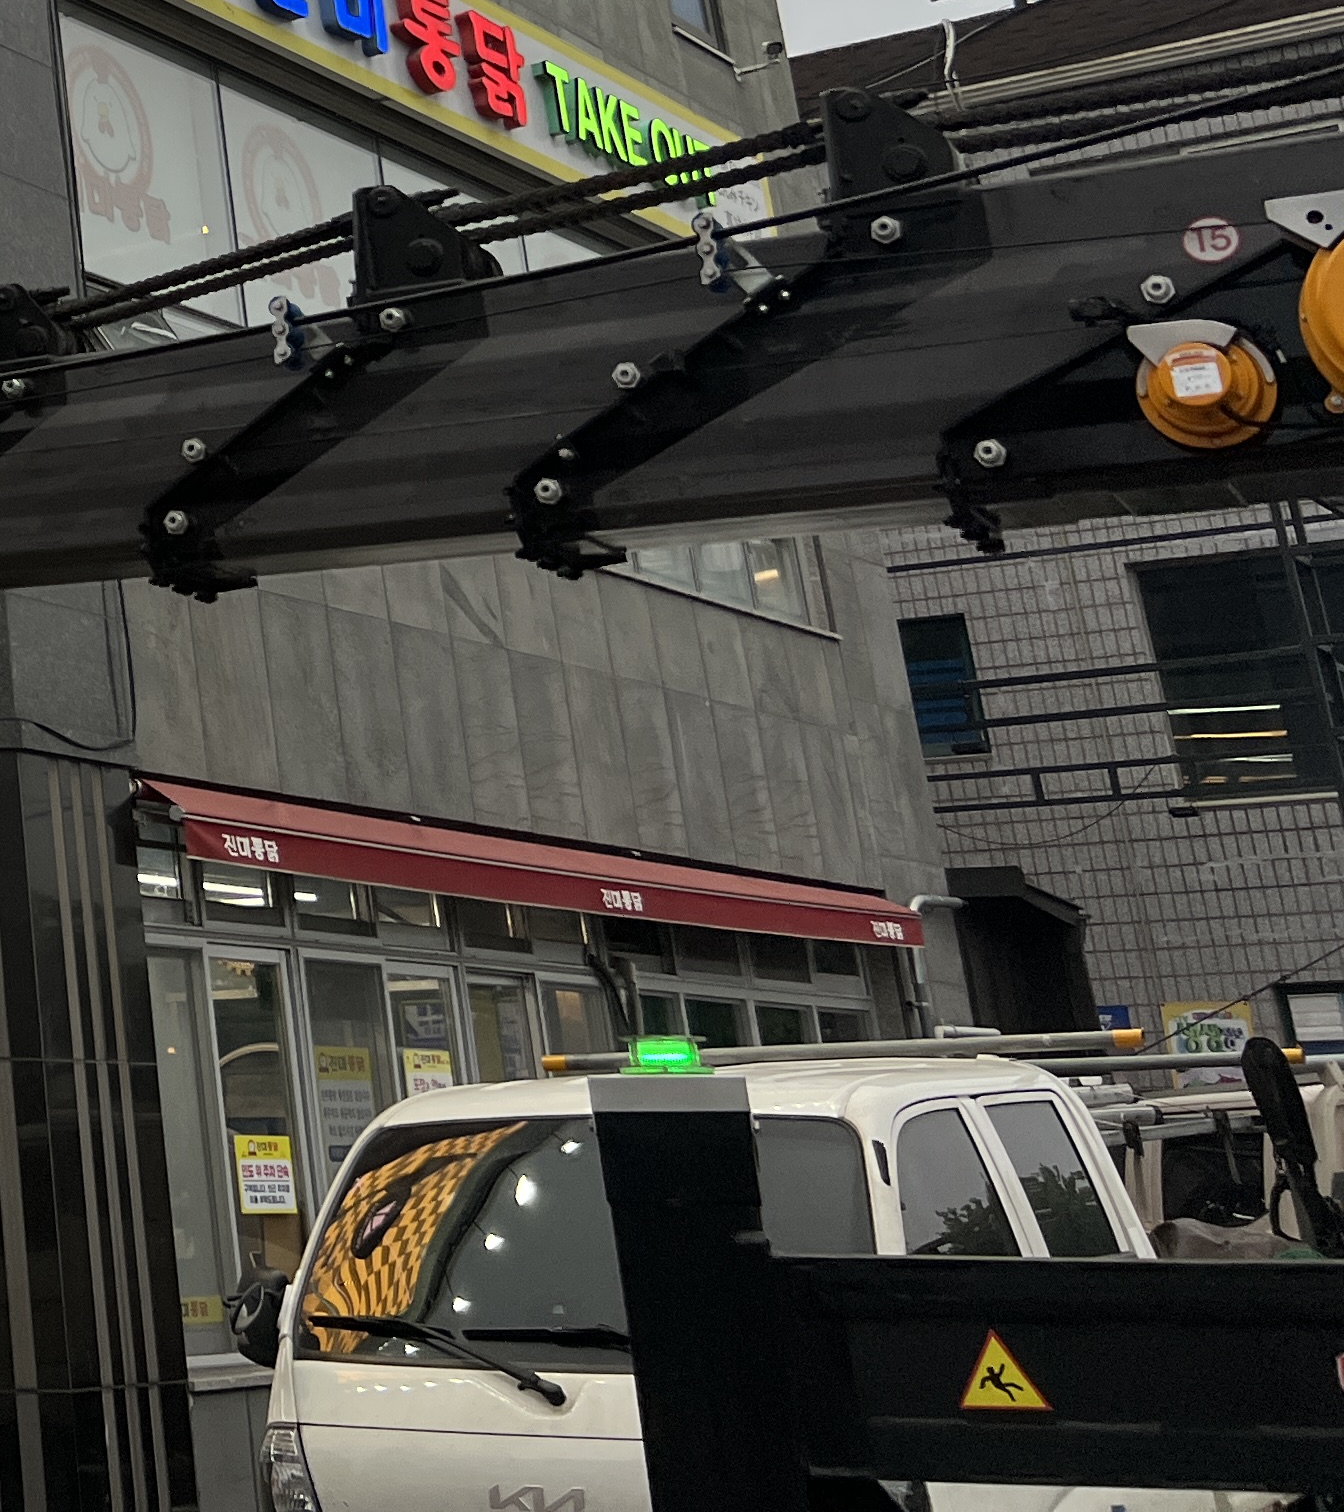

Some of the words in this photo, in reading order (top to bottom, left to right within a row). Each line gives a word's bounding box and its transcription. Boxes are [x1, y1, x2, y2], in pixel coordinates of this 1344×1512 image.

[540, 60, 648, 167] TAKE
[221, 832, 280, 864] 진미통닭
[601, 888, 643, 912] 진미통닭
